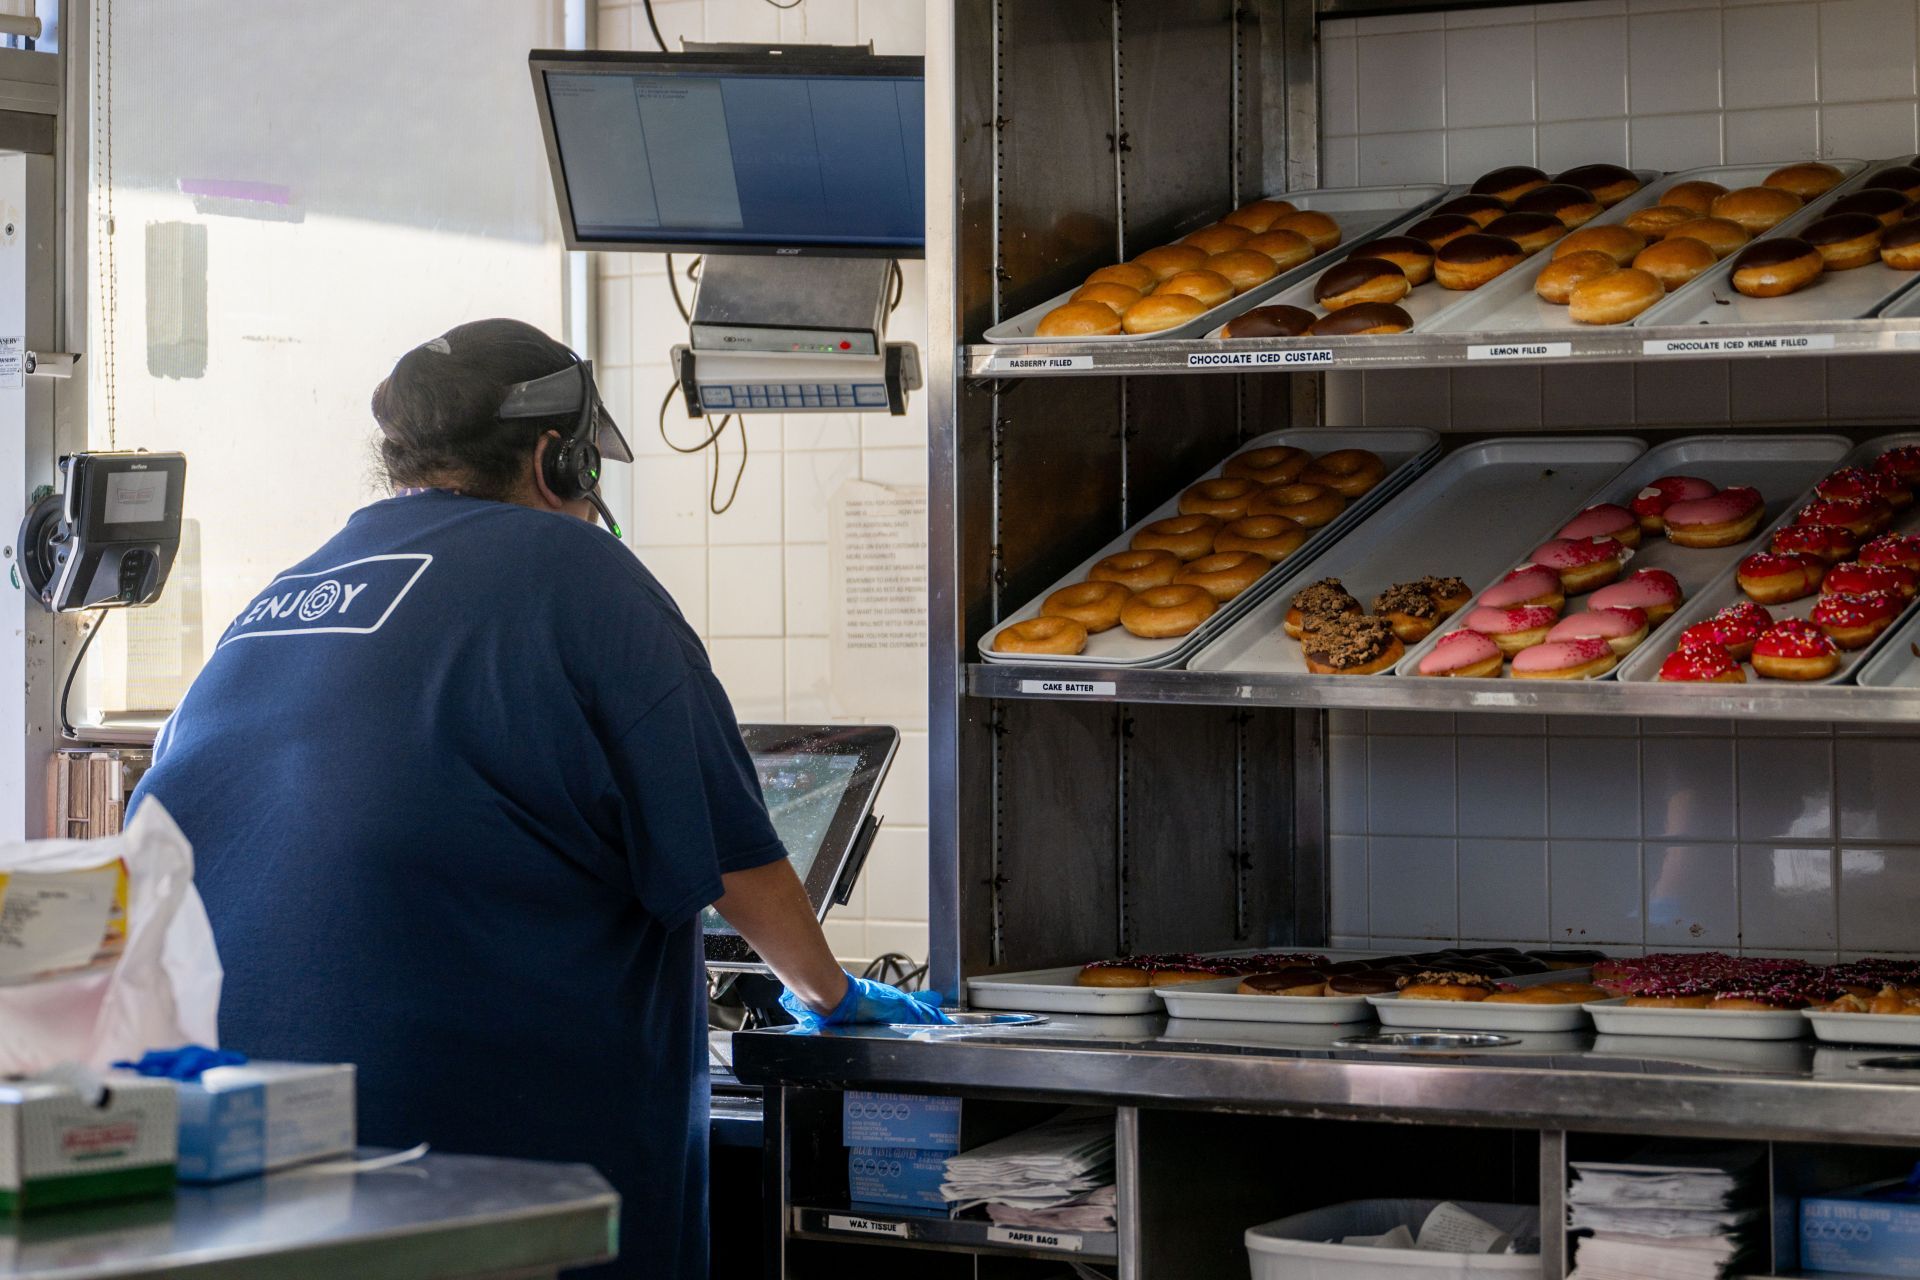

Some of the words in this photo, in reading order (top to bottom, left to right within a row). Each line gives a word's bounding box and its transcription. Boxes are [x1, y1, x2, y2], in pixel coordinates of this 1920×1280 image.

[1667, 341, 1719, 350] CHOCOLATE
[1724, 341, 1744, 349] ICED
[1747, 339, 1777, 348] KREME
[1781, 338, 1808, 347] FILLED
[1490, 347, 1519, 356] LEMON
[1522, 346, 1547, 354] FILLED
[1190, 355, 1252, 365] CHOCOLATE
[1256, 354, 1281, 363] ICED
[1285, 352, 1331, 362] CUSTARD
[241, 580, 368, 626] ENJOY
[1043, 683, 1062, 691] CAKE
[1065, 684, 1094, 692] BATTER
[849, 1220, 868, 1229] WAX
[871, 1222, 897, 1232] TISSUE
[1009, 1232, 1033, 1242] PAPER
[1036, 1235, 1058, 1245] BAGS
